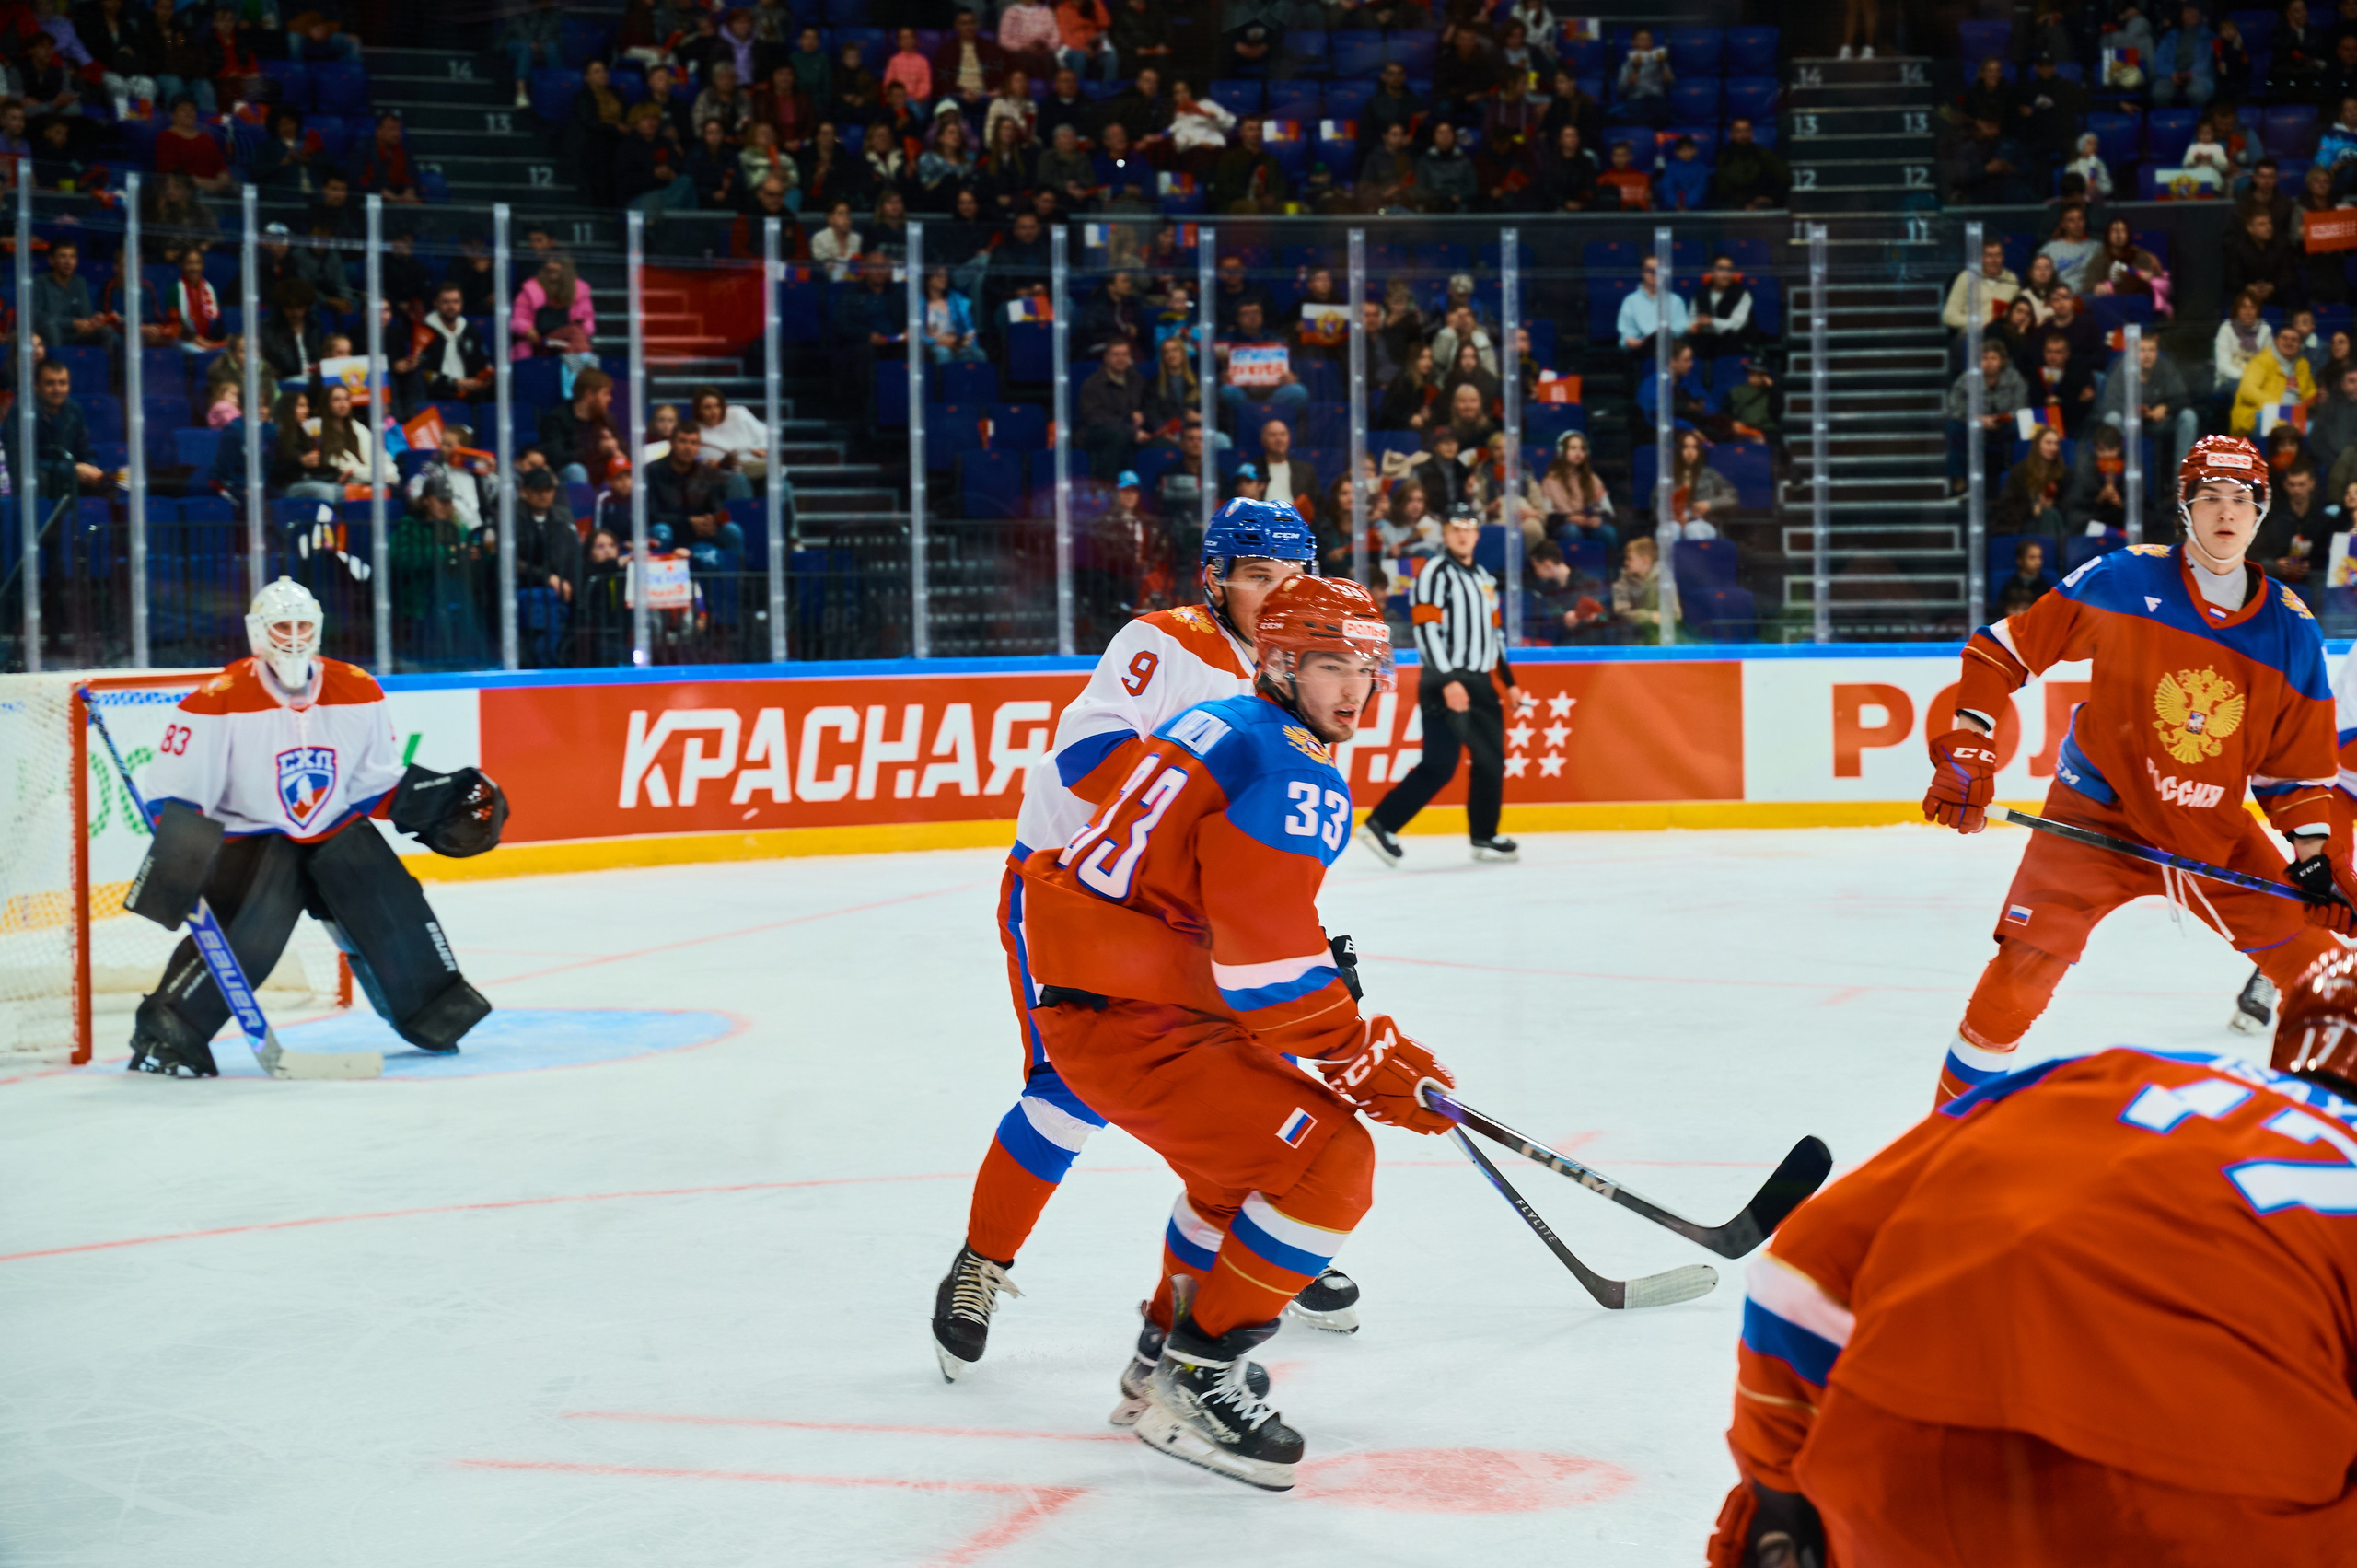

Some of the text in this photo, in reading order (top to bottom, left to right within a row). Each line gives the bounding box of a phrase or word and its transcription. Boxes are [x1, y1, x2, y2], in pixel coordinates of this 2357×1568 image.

[448, 59, 475, 80] 14
[1799, 66, 1822, 86] 14
[1900, 64, 1924, 85] 14
[485, 113, 512, 134] 13
[1794, 115, 1818, 135] 13
[1903, 112, 1929, 134] 13
[528, 166, 553, 188] 12
[1793, 169, 1817, 190] 12
[1903, 167, 1929, 188] 12
[572, 222, 592, 245] 11
[2211, 455, 2250, 466] РОЛЬФ
[1346, 622, 1389, 638] РОЛЬФ
[1120, 649, 1160, 697] 9
[160, 724, 192, 756] 83
[278, 749, 335, 776] СХЛ
[619, 701, 1052, 808] КРАСНАЯ
[1953, 747, 1997, 764] CC
[1284, 781, 1350, 853] 33
[197, 929, 264, 1029] BAUER
[1329, 1027, 1398, 1094] CCM
[1515, 1199, 1558, 1243] FLYLITE
